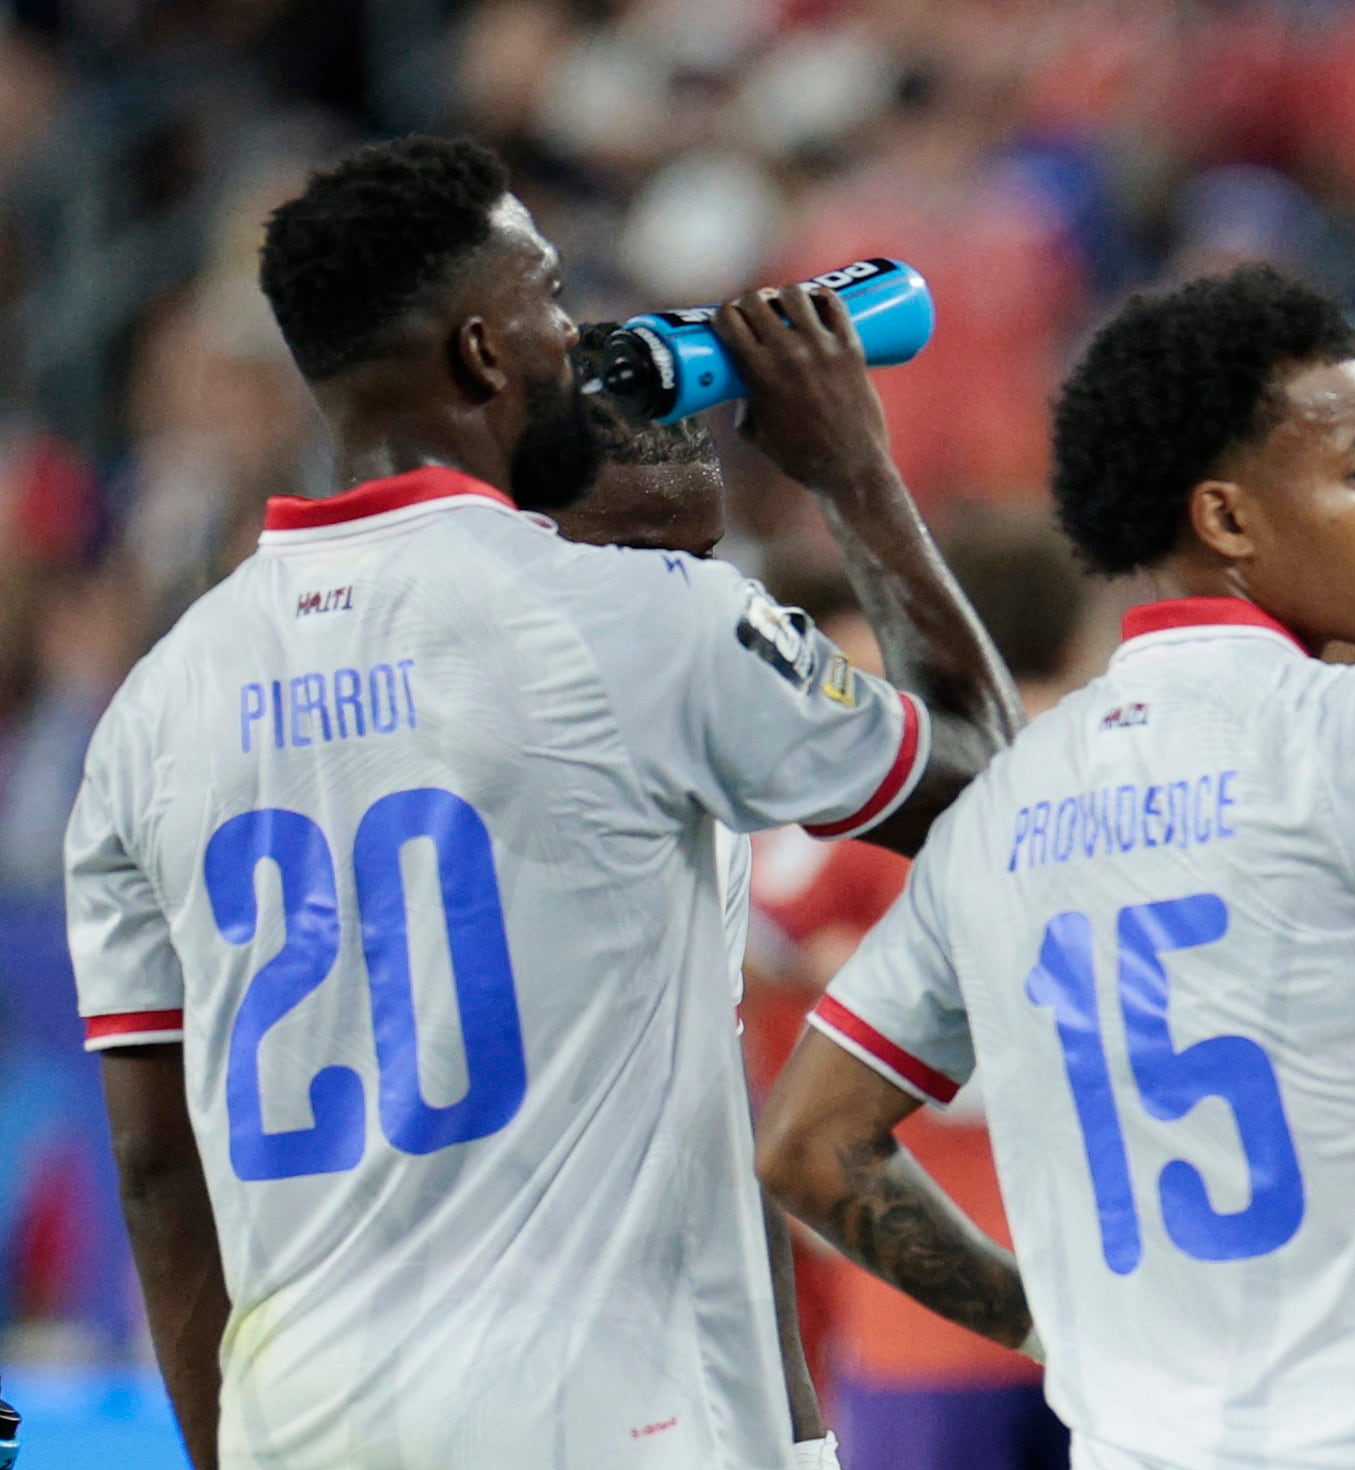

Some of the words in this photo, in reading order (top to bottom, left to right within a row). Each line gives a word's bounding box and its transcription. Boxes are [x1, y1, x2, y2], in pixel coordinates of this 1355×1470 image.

[296, 585, 353, 618] HAITI
[240, 658, 417, 754] PIERROT
[1007, 769, 1238, 873] PROVIDENCE
[203, 787, 528, 1181] 20
[1026, 892, 1306, 1276] 15
